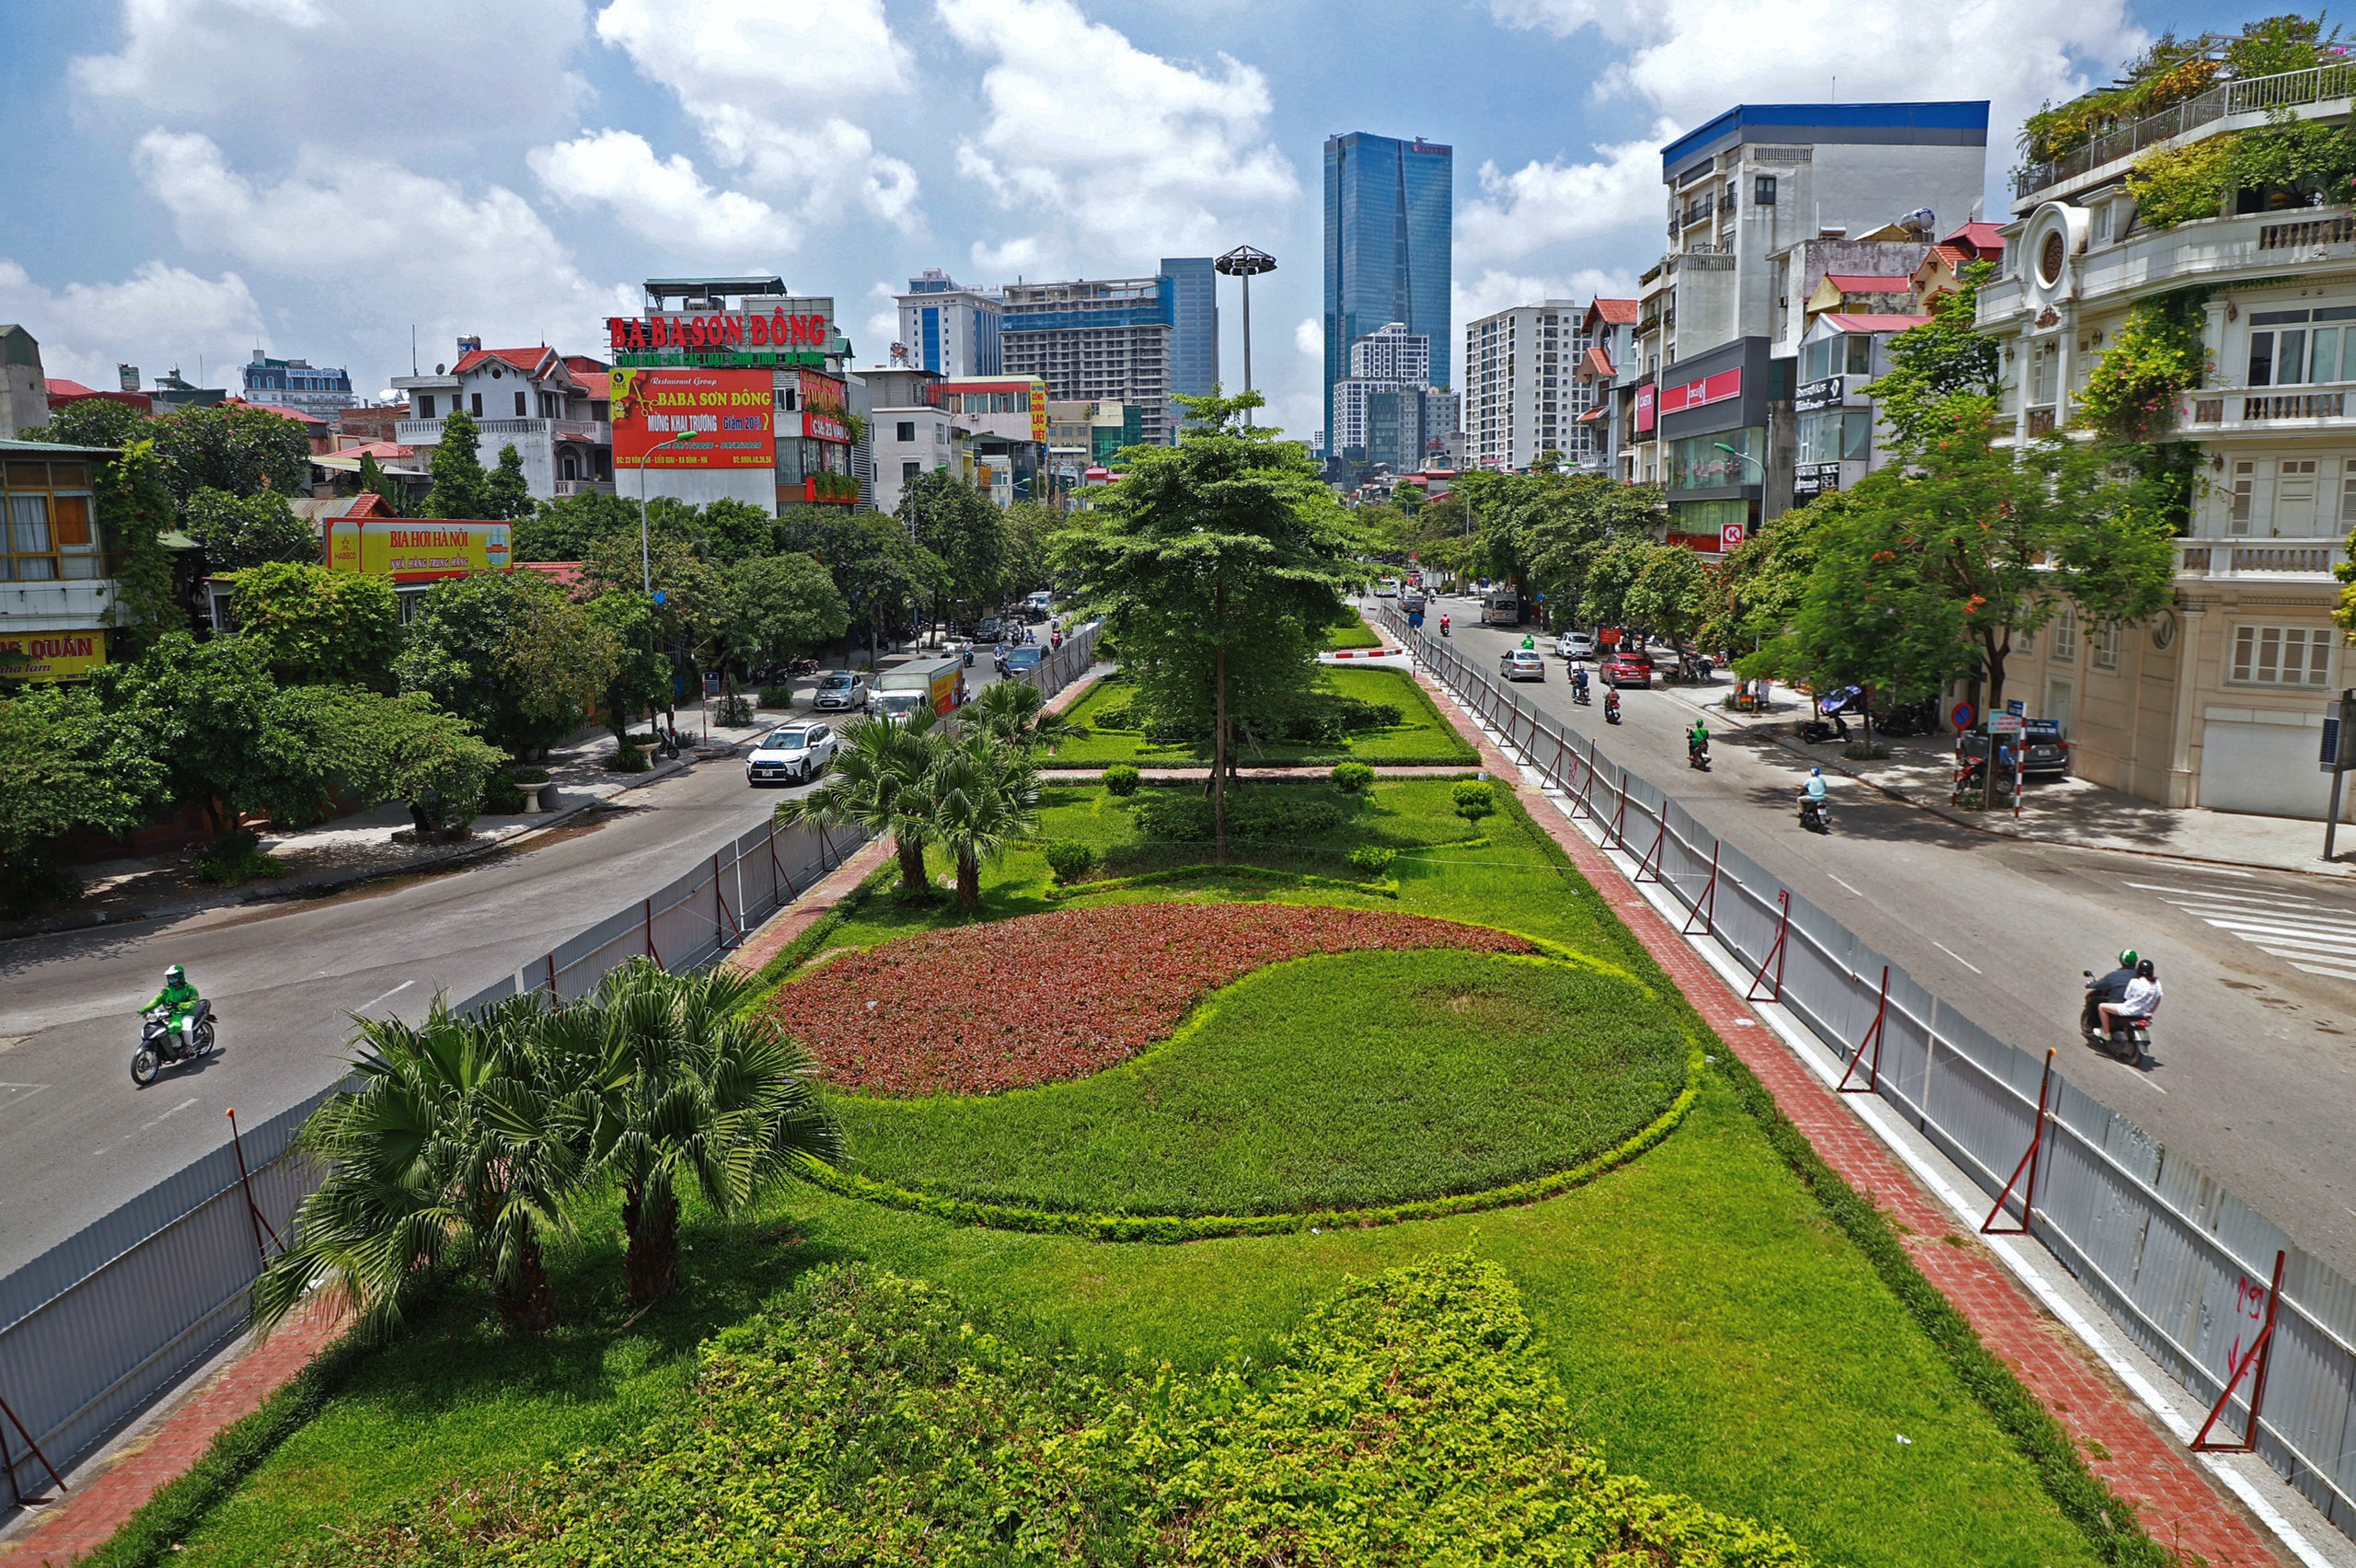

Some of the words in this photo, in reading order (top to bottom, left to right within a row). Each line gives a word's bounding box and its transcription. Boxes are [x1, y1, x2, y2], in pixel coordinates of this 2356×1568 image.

[691, 309, 743, 345] SƠN
[749, 306, 826, 345] ĐÔNG
[693, 376, 717, 386] Group
[658, 392, 697, 406] BABA
[699, 390, 728, 406] SƠN
[731, 388, 771, 406] ĐÔNG
[671, 415, 687, 432] KHAI
[745, 416, 762, 431] 20%
[389, 530, 410, 548] BIA
[410, 530, 432, 548] HƠI
[433, 526, 448, 547] HÀ
[449, 527, 468, 550] NỘI
[29, 634, 92, 660] QUÁN
